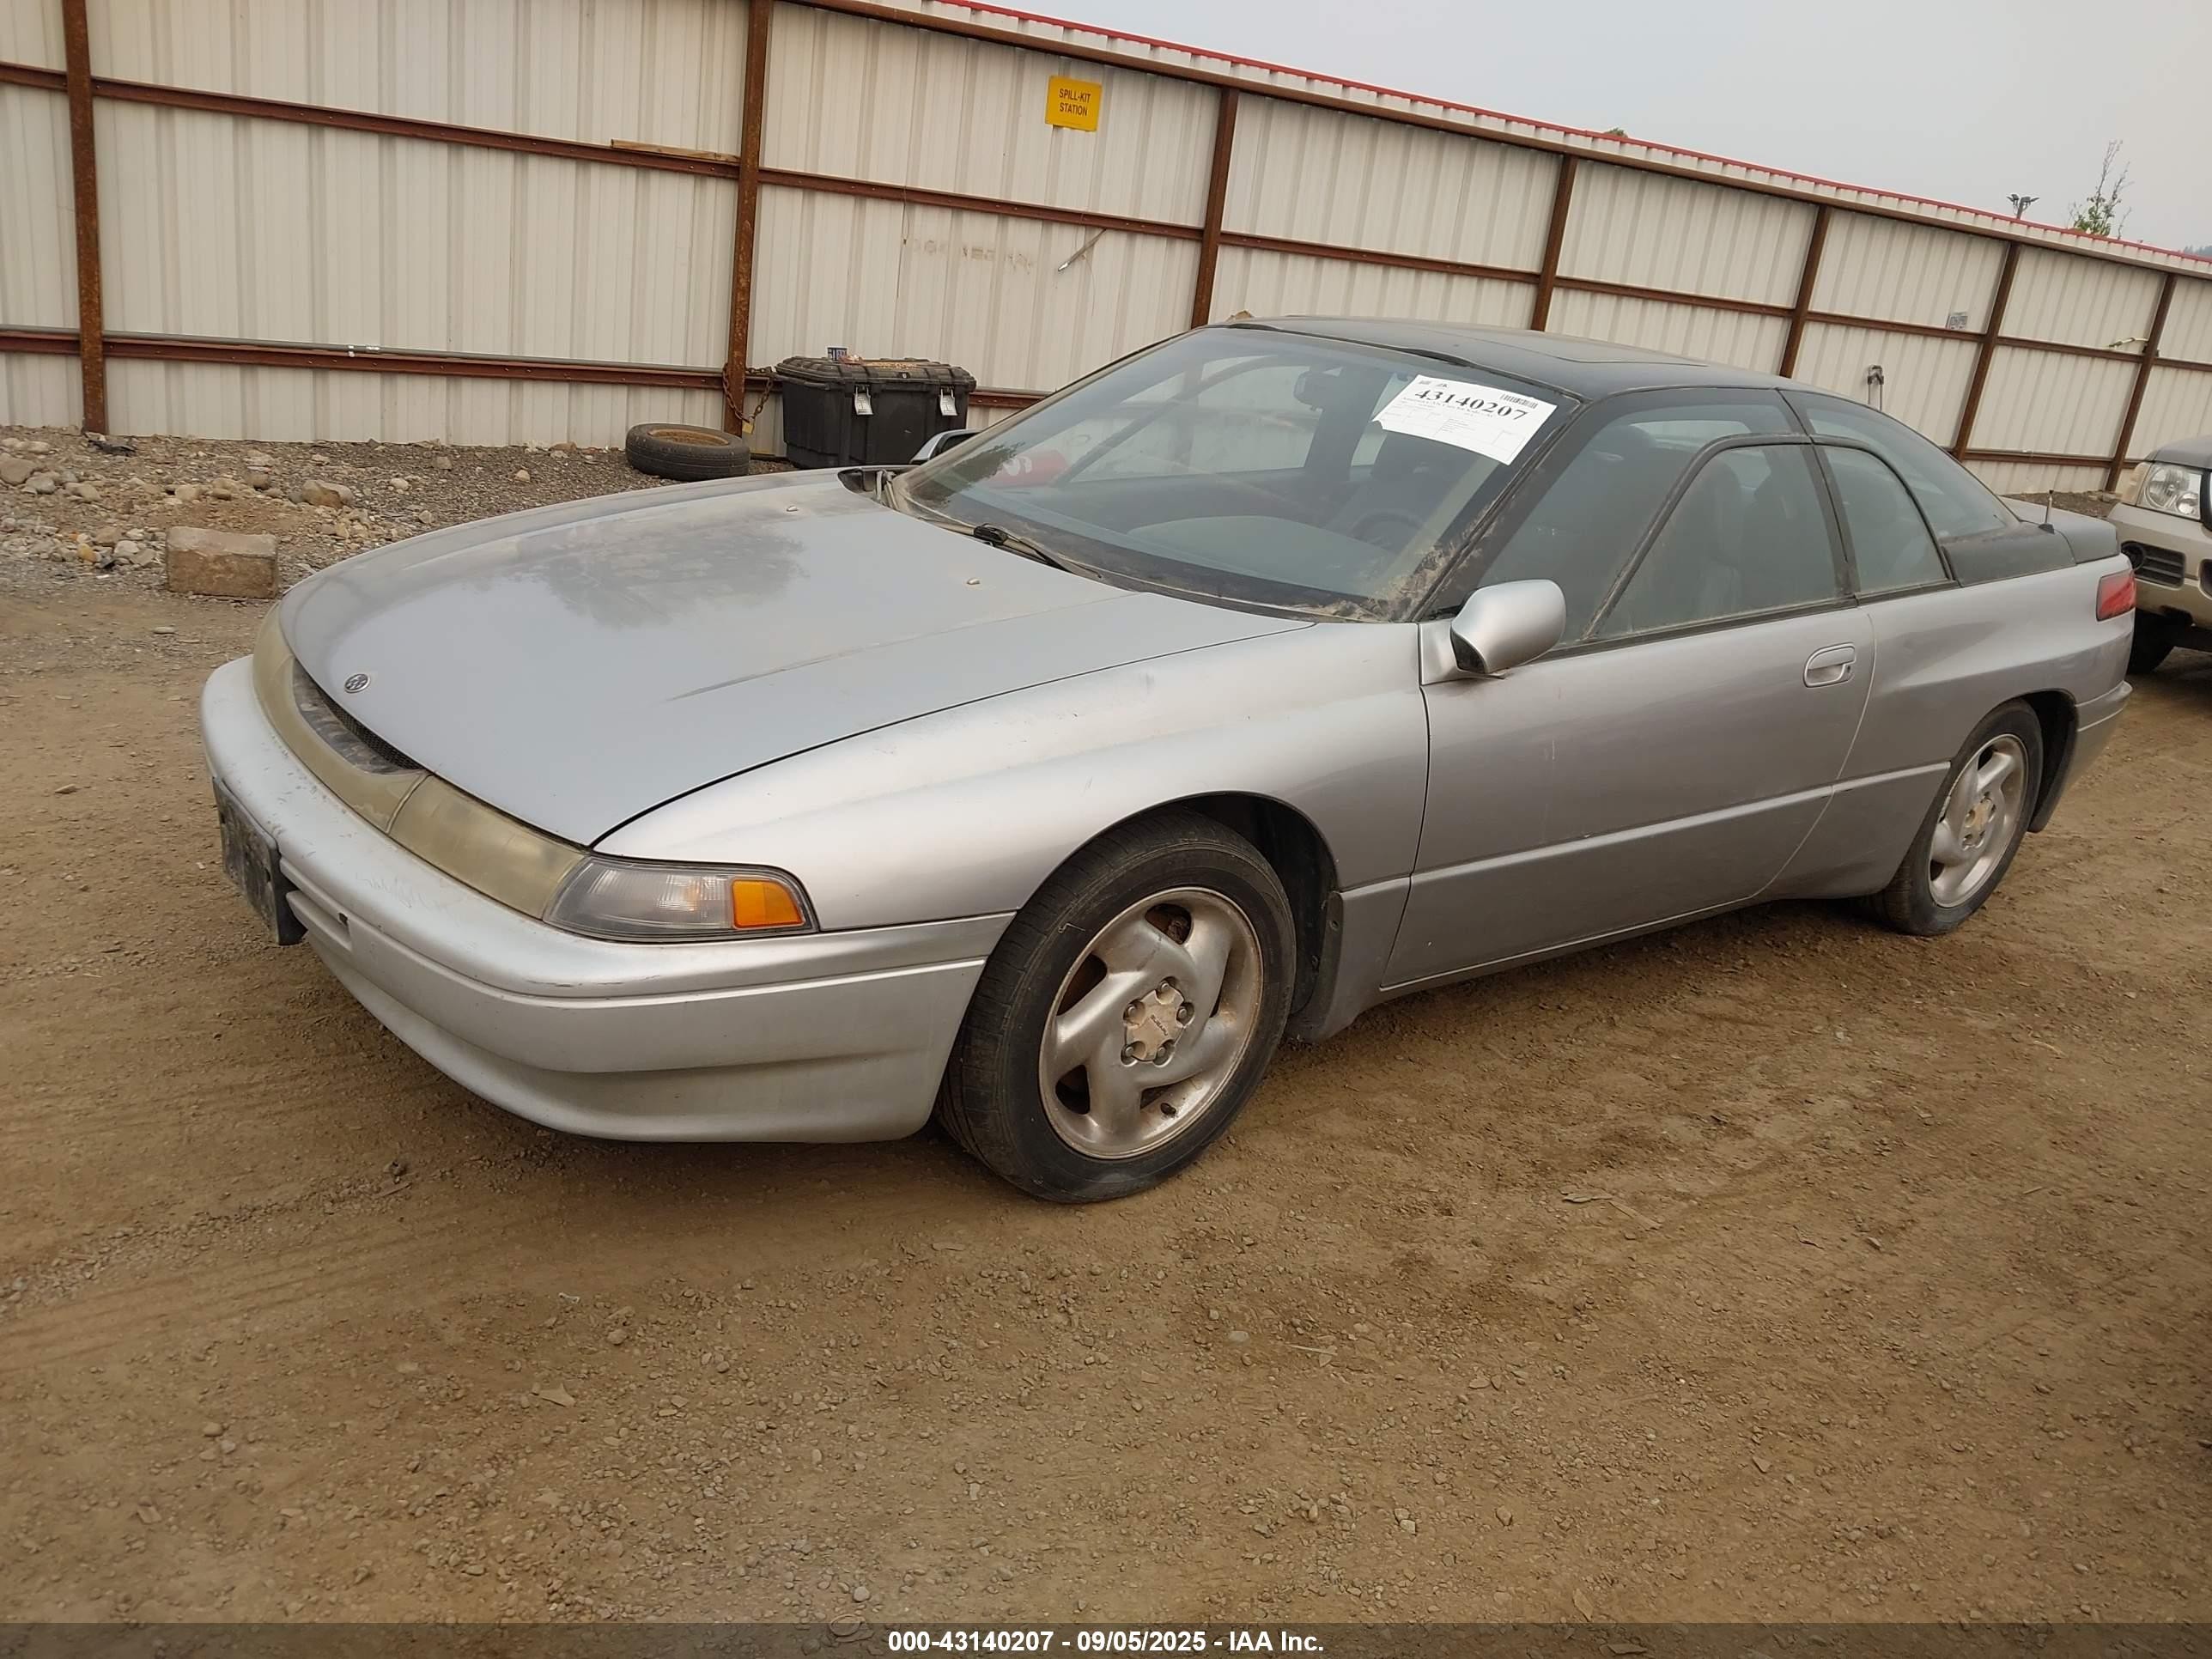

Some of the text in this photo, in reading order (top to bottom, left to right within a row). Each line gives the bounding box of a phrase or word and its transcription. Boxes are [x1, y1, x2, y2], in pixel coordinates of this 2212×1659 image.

[1059, 88, 1091, 103] SPILL-KIT
[1060, 102, 1088, 116] STATION
[1414, 390, 1528, 420] 43140207
